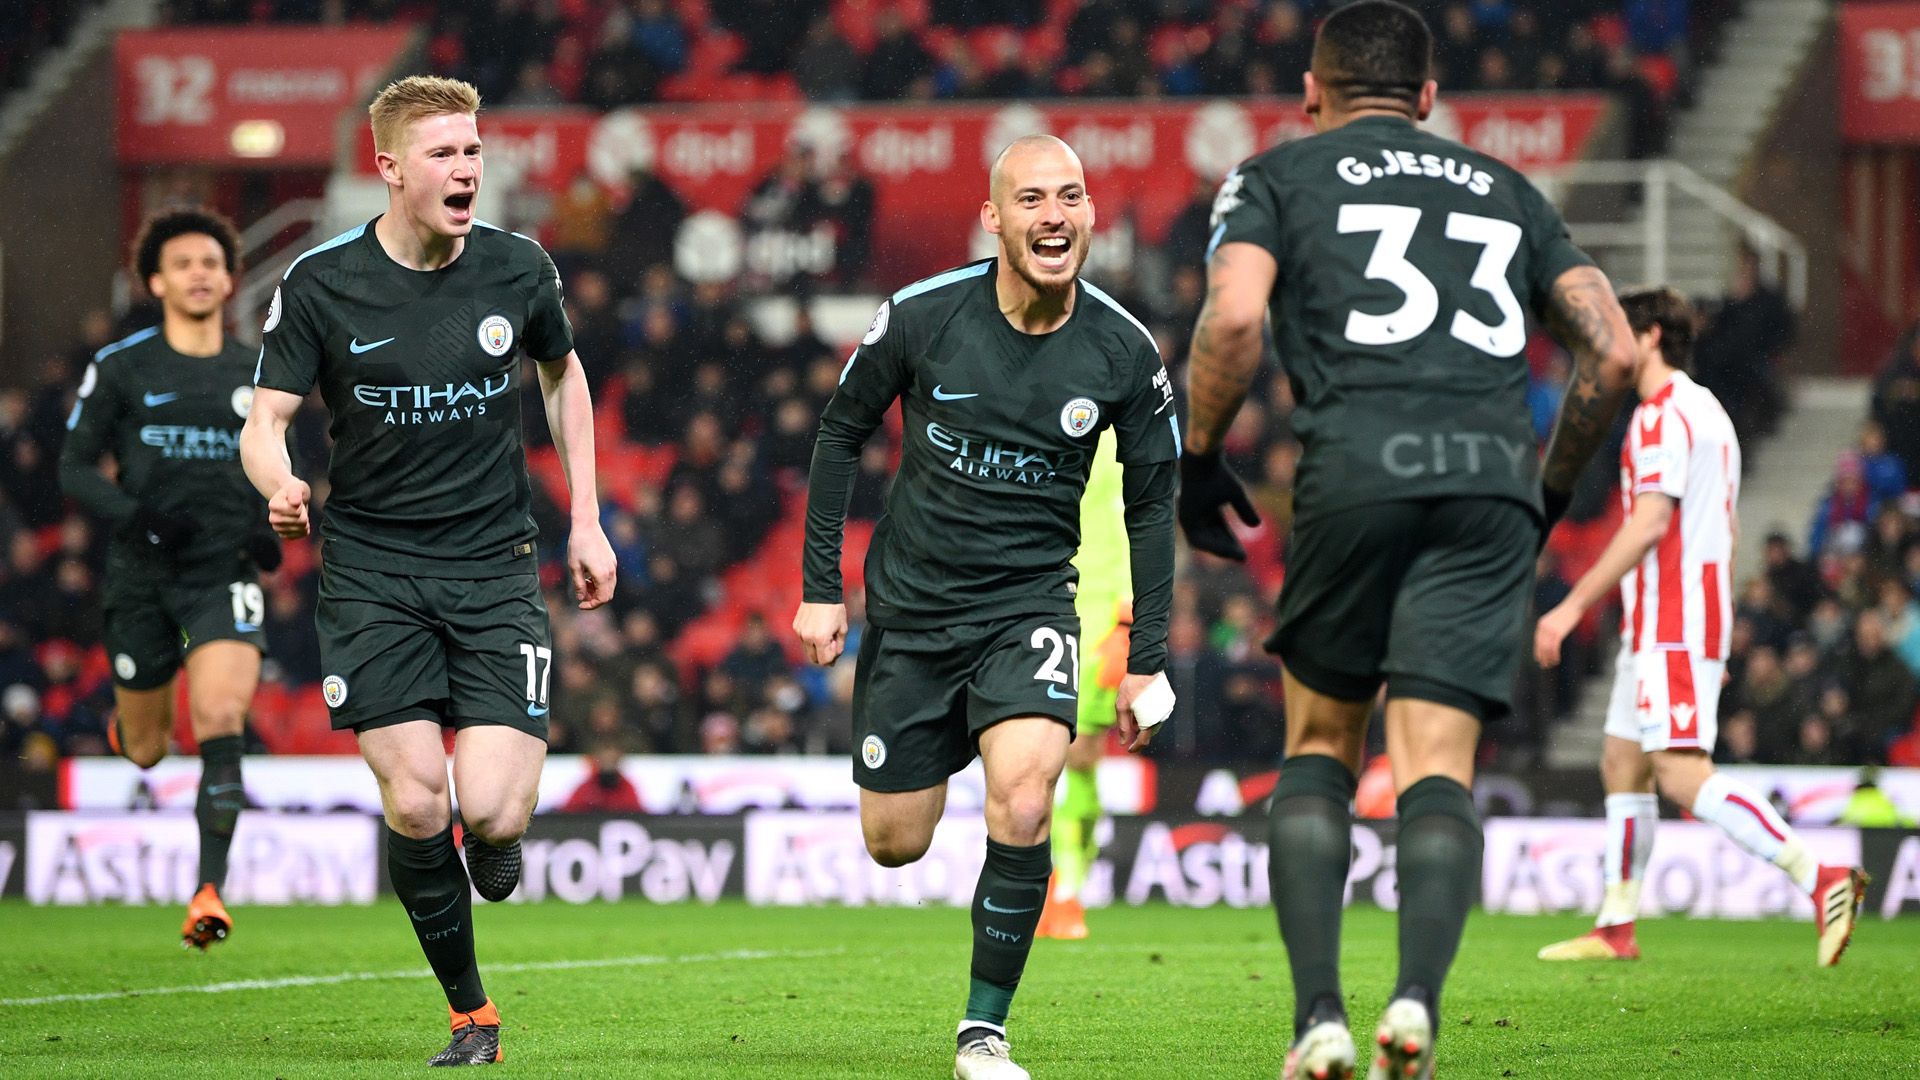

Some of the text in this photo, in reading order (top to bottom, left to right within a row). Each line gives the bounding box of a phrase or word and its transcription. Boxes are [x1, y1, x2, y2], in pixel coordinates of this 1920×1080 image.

[1336, 149, 1494, 196] G.JESUS
[1336, 203, 1527, 358] 33
[353, 373, 509, 409] ETIHAD
[384, 402, 486, 425] AIRWAYS
[140, 424, 241, 450] ETIHA
[926, 422, 1087, 470] ETIHAD
[1381, 432, 1528, 479] CITY
[950, 456, 1056, 484] AIRWAYS
[229, 581, 265, 627] 19
[520, 643, 552, 705] 17
[1030, 626, 1079, 693] 21
[986, 926, 1021, 943] CITY
